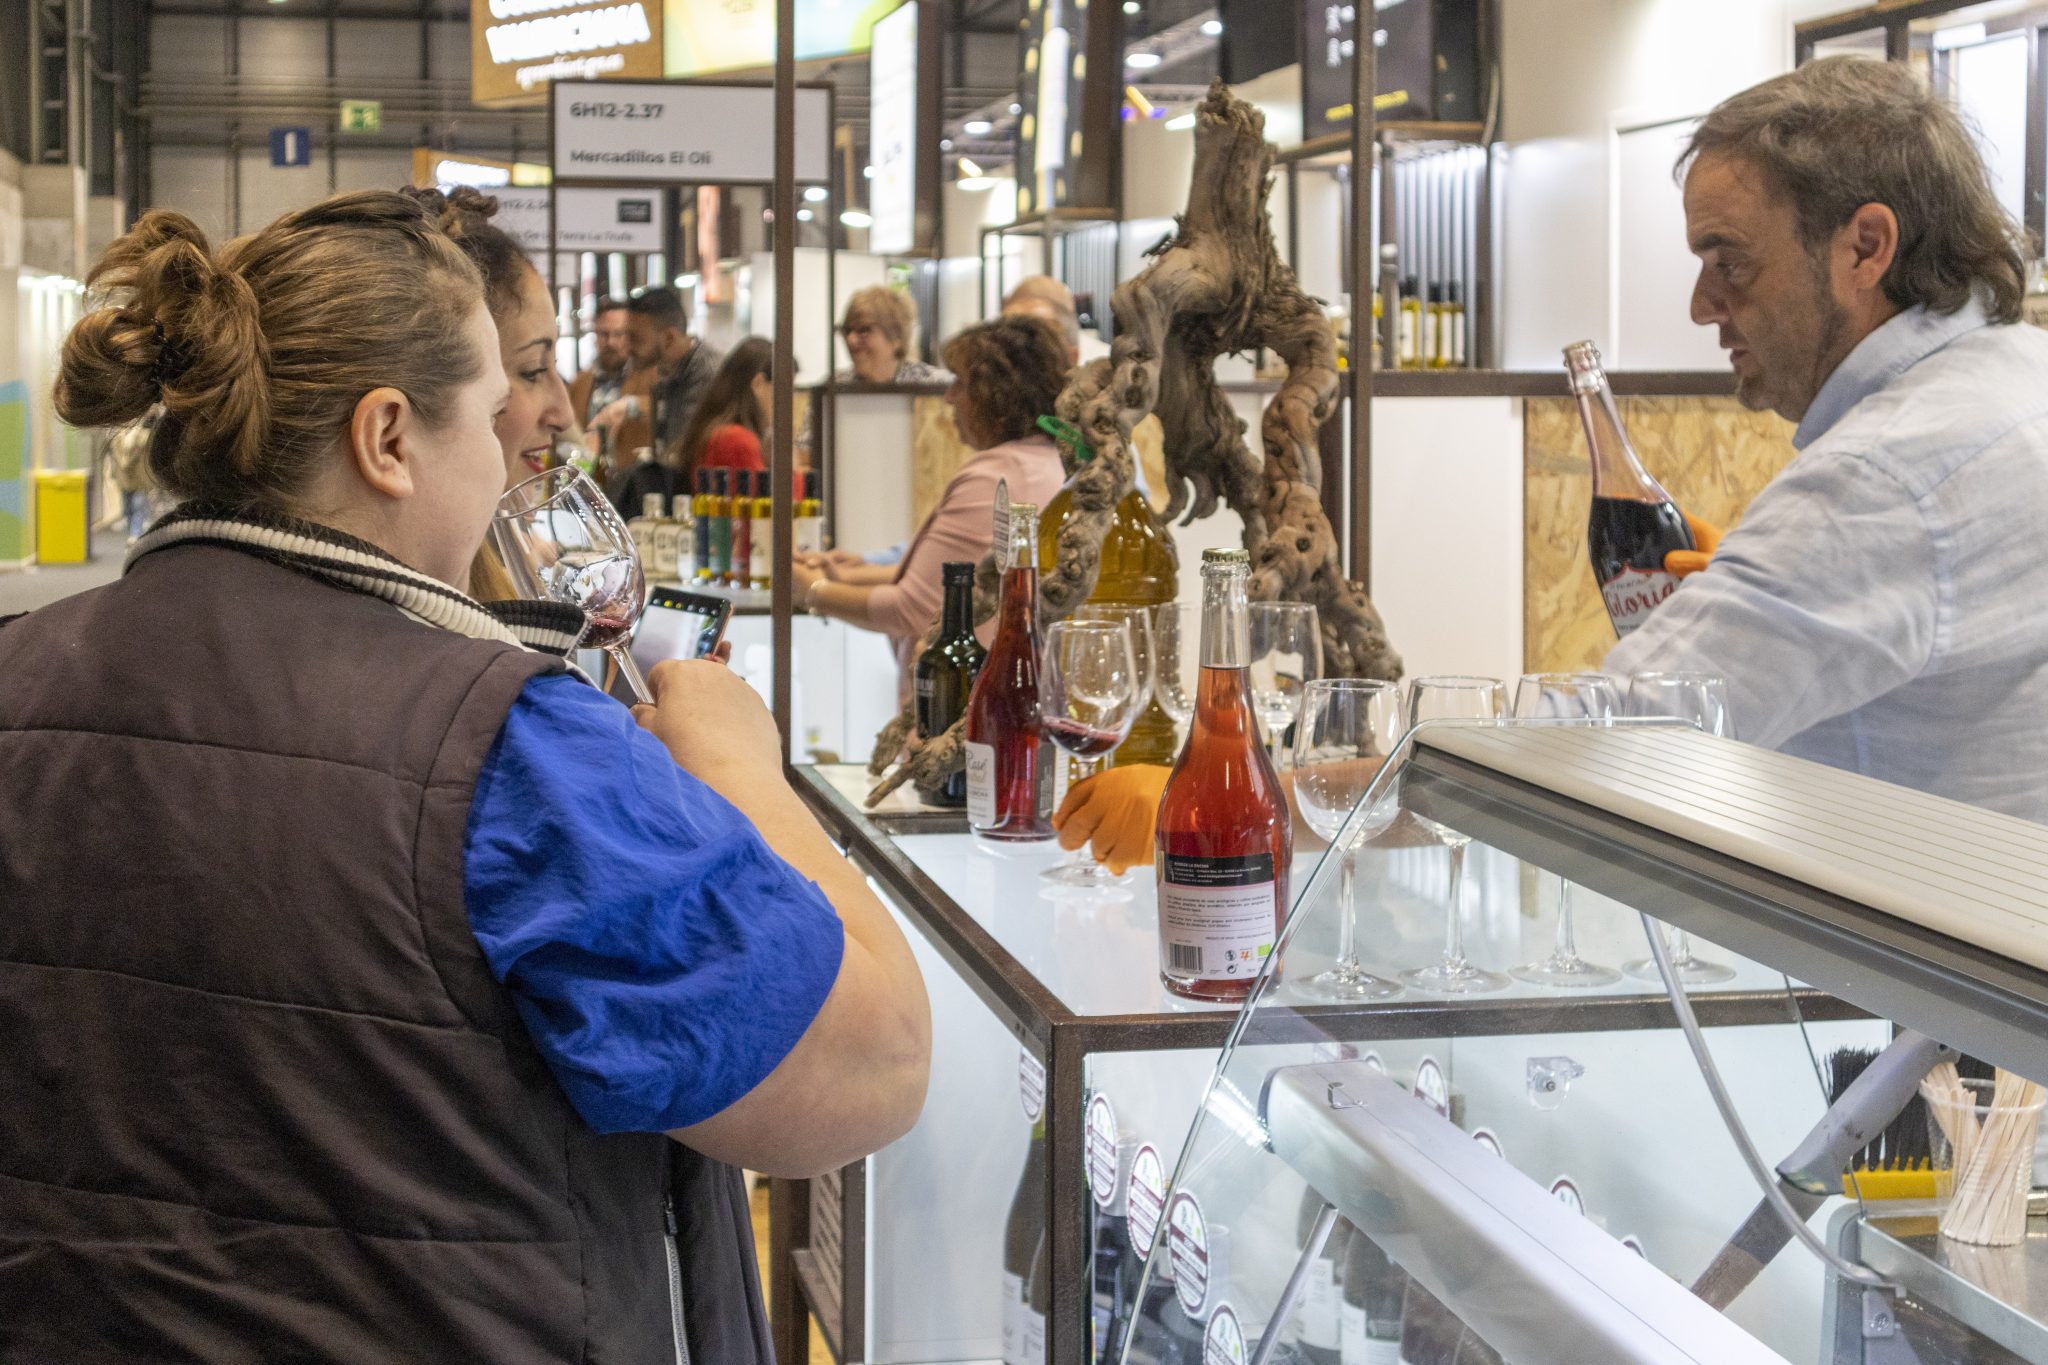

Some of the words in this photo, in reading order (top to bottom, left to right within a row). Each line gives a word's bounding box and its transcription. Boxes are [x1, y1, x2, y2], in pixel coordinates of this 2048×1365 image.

[569, 102, 664, 119] 6H12-2.37
[569, 149, 665, 165] Mercadillos
[670, 150, 684, 164] El
[688, 150, 712, 165] Oli
